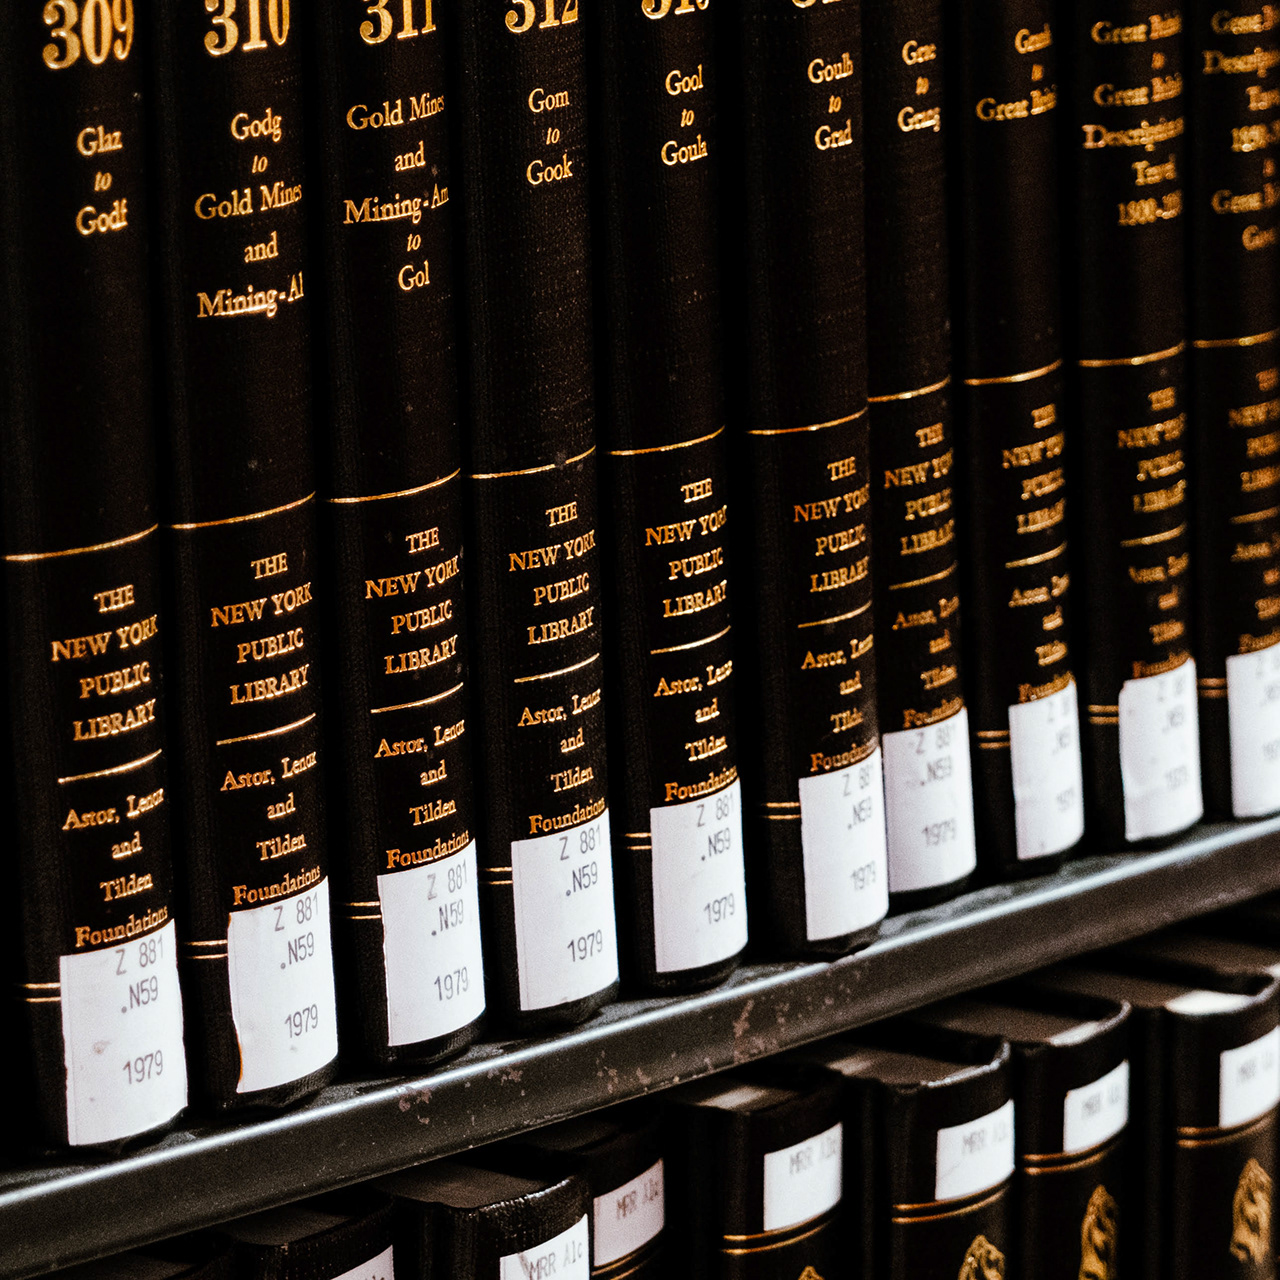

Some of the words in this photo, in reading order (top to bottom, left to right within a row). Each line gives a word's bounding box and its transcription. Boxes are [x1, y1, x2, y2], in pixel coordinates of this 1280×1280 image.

[665, 64, 703, 96] Gool
[347, 99, 404, 130] Gold
[528, 88, 570, 113] Gom
[231, 108, 282, 143] Godg
[681, 109, 694, 127] to
[546, 127, 560, 145] to
[661, 134, 708, 166] Goula
[252, 155, 268, 173] to
[395, 142, 425, 171] and
[526, 153, 573, 185] Gook
[195, 188, 253, 219] Gold
[244, 231, 279, 263] and
[407, 234, 421, 252] to
[398, 260, 430, 291] Gol
[680, 478, 712, 503] THE
[545, 501, 578, 527] THE
[405, 527, 440, 554] THE
[645, 519, 696, 546] NEW
[251, 552, 288, 579] THE
[509, 544, 561, 571] NEW
[563, 530, 595, 560] YORK
[669, 547, 723, 580] PUBLIC
[365, 571, 421, 599] NEW
[424, 555, 459, 588] YORK
[534, 572, 589, 606] PUBLIC
[93, 584, 135, 613] THE
[211, 598, 267, 627] NEW
[271, 582, 312, 616] YORK
[391, 599, 452, 634] PUBLIC
[527, 607, 594, 645] LIBRARY
[52, 632, 112, 661] NEW
[116, 614, 158, 649] YORK
[237, 627, 304, 663] PUBLIC
[384, 635, 456, 674] LIBRARY
[80, 661, 151, 698] PUBLIC
[230, 664, 309, 705] LIBRARY
[73, 698, 156, 741] LIBRARY
[518, 706, 567, 726] Astor,
[695, 698, 720, 723] and
[374, 738, 428, 758] Astor,
[560, 727, 585, 753] and
[220, 770, 275, 791] Astor,
[420, 759, 447, 786] and
[551, 766, 594, 792] Tilden
[267, 792, 296, 820] and
[409, 800, 456, 826] Tilden
[112, 831, 143, 860] and
[256, 834, 307, 861] Tilden
[386, 830, 469, 869] Foundations
[559, 836, 569, 861] Z
[580, 824, 602, 854] 881
[100, 873, 153, 901] Tilden
[233, 866, 320, 904] Foundations
[448, 859, 468, 894] 881
[566, 861, 598, 897] .N59
[274, 905, 285, 932] Z
[296, 891, 319, 924] 881
[431, 899, 464, 937] .N59
[705, 893, 735, 924] 1979
[115, 948, 127, 976] Z
[139, 934, 163, 968] 881
[280, 932, 314, 970] .N59
[567, 929, 603, 962] 1979
[434, 967, 469, 1001] 1979
[284, 1004, 319, 1039] 1979
[123, 1050, 163, 1085] 1979
